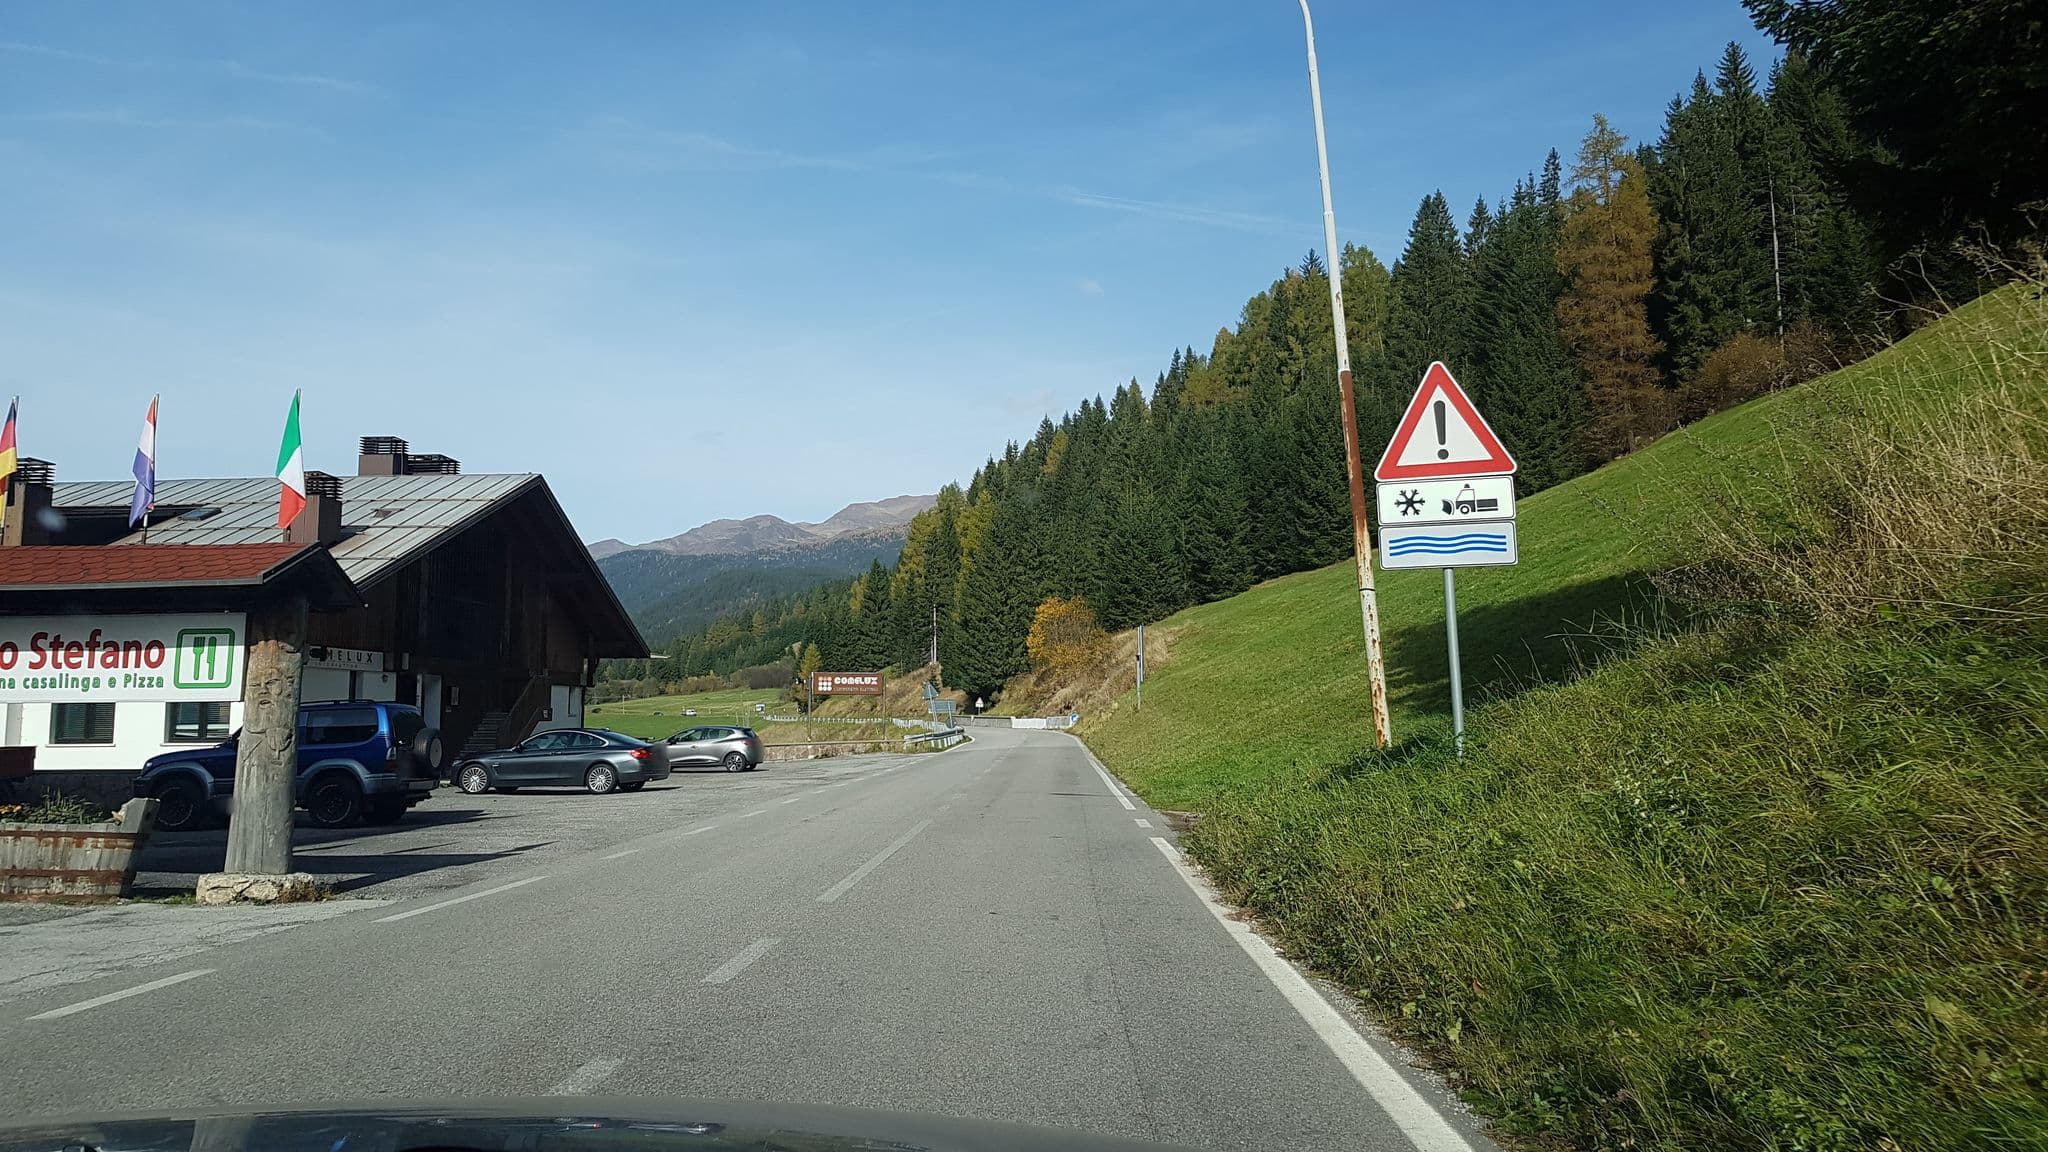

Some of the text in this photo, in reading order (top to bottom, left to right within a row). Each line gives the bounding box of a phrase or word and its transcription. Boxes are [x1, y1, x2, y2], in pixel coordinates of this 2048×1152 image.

[28, 629, 166, 670] Stefano
[326, 649, 373, 663] MELUX
[23, 673, 101, 692] casalinga
[108, 676, 117, 689] e
[123, 673, 164, 689] Pizza
